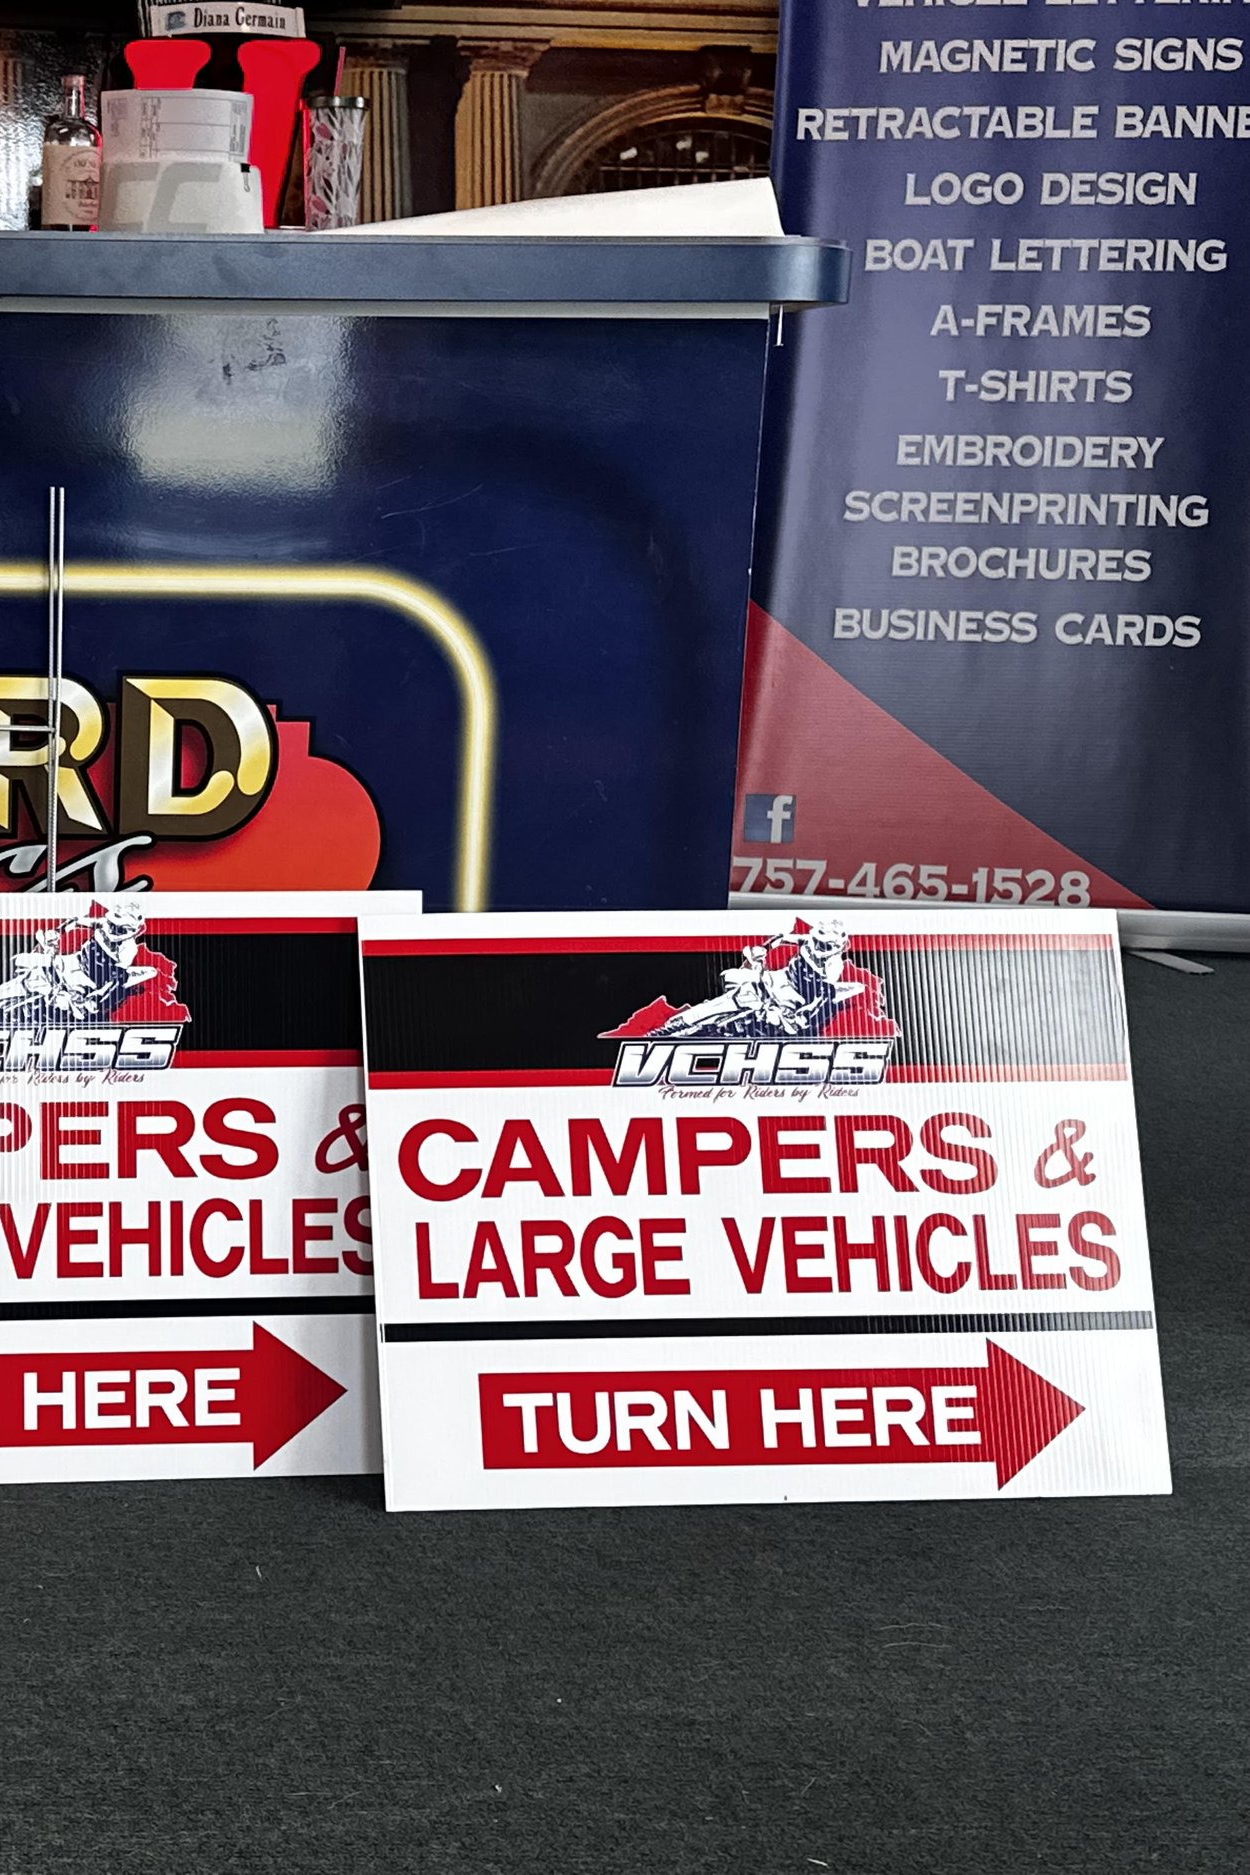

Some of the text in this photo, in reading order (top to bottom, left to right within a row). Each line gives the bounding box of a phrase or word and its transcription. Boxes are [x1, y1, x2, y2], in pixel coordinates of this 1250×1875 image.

[193, 6, 287, 30] Diana Germain
[879, 37, 1243, 73] MAGNETIC SIGNS
[796, 105, 1099, 141] RETRACTABLE
[905, 172, 1198, 206] LOGO DESIGN
[864, 238, 1228, 273] BOAT LETTERING
[930, 304, 1152, 338] A-FRAMES
[939, 369, 1133, 404] T-SHIRTS
[896, 434, 1164, 469] EMBROIDERY
[844, 490, 1209, 528] SCREENPRINTING
[892, 545, 1152, 582] BROCHURES
[833, 607, 1202, 647] BUSINESS CARDS
[732, 856, 1091, 908] 757-465-1528
[75, 1072, 95, 1088] by
[102, 1070, 145, 1086] Riders
[613, 1039, 892, 1087] VCHSS
[658, 1085, 859, 1103] Formed for Riders by Riders
[314, 1103, 368, 1173] &
[397, 1111, 1096, 1202] CAMPERS &
[415, 1210, 1121, 1299] LARGE VEHICLES
[23, 1366, 241, 1430] HERE
[502, 1384, 982, 1455] TURN HERE
